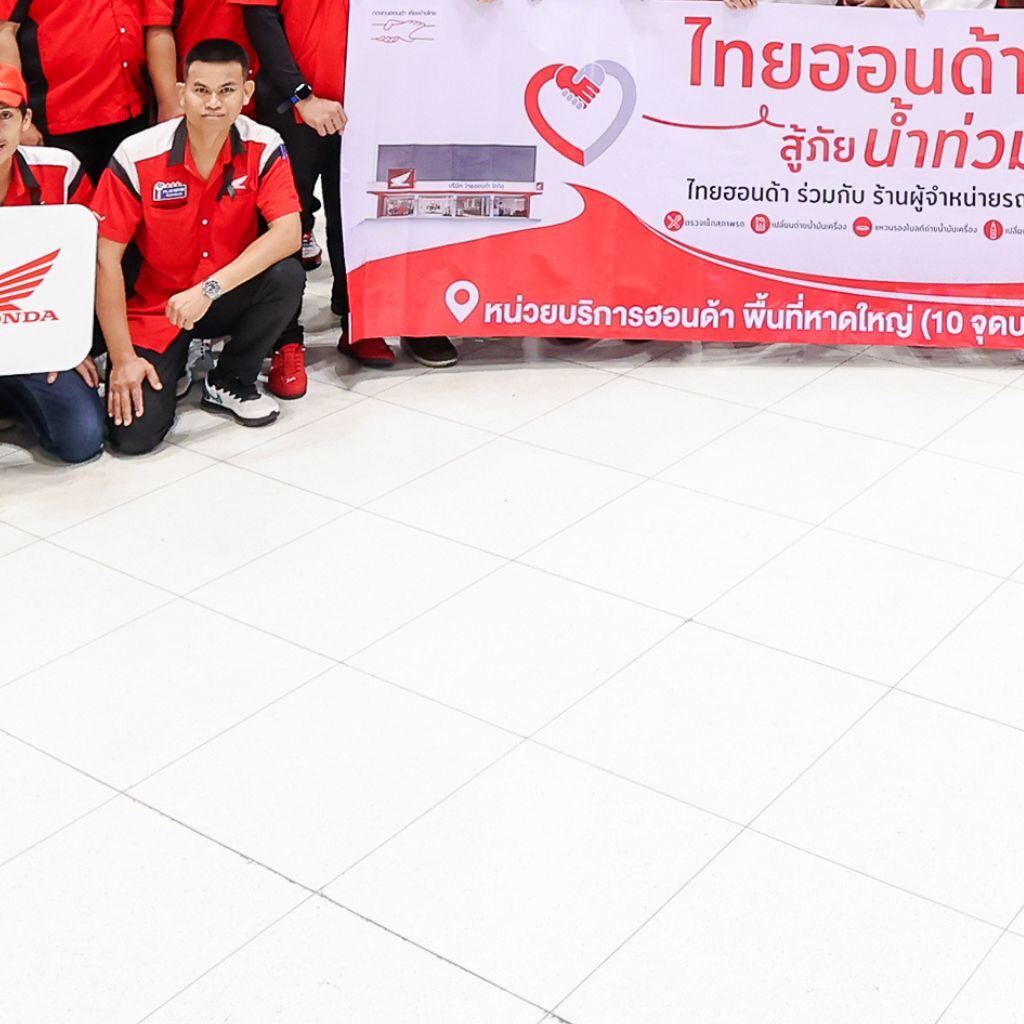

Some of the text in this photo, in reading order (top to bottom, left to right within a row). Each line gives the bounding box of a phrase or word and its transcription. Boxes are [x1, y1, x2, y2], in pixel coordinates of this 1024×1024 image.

[780, 124, 855, 173] สู้ภัย
[687, 178, 790, 203] ไทยฮอนด้า
[797, 183, 864, 205] ร่วมกับ
[0, 309, 59, 324] NDA
[484, 294, 734, 329] หน่วยบริการฮอนด้า
[742, 293, 914, 337] พื้นที่หาดใหญ่
[921, 307, 963, 341] (10
